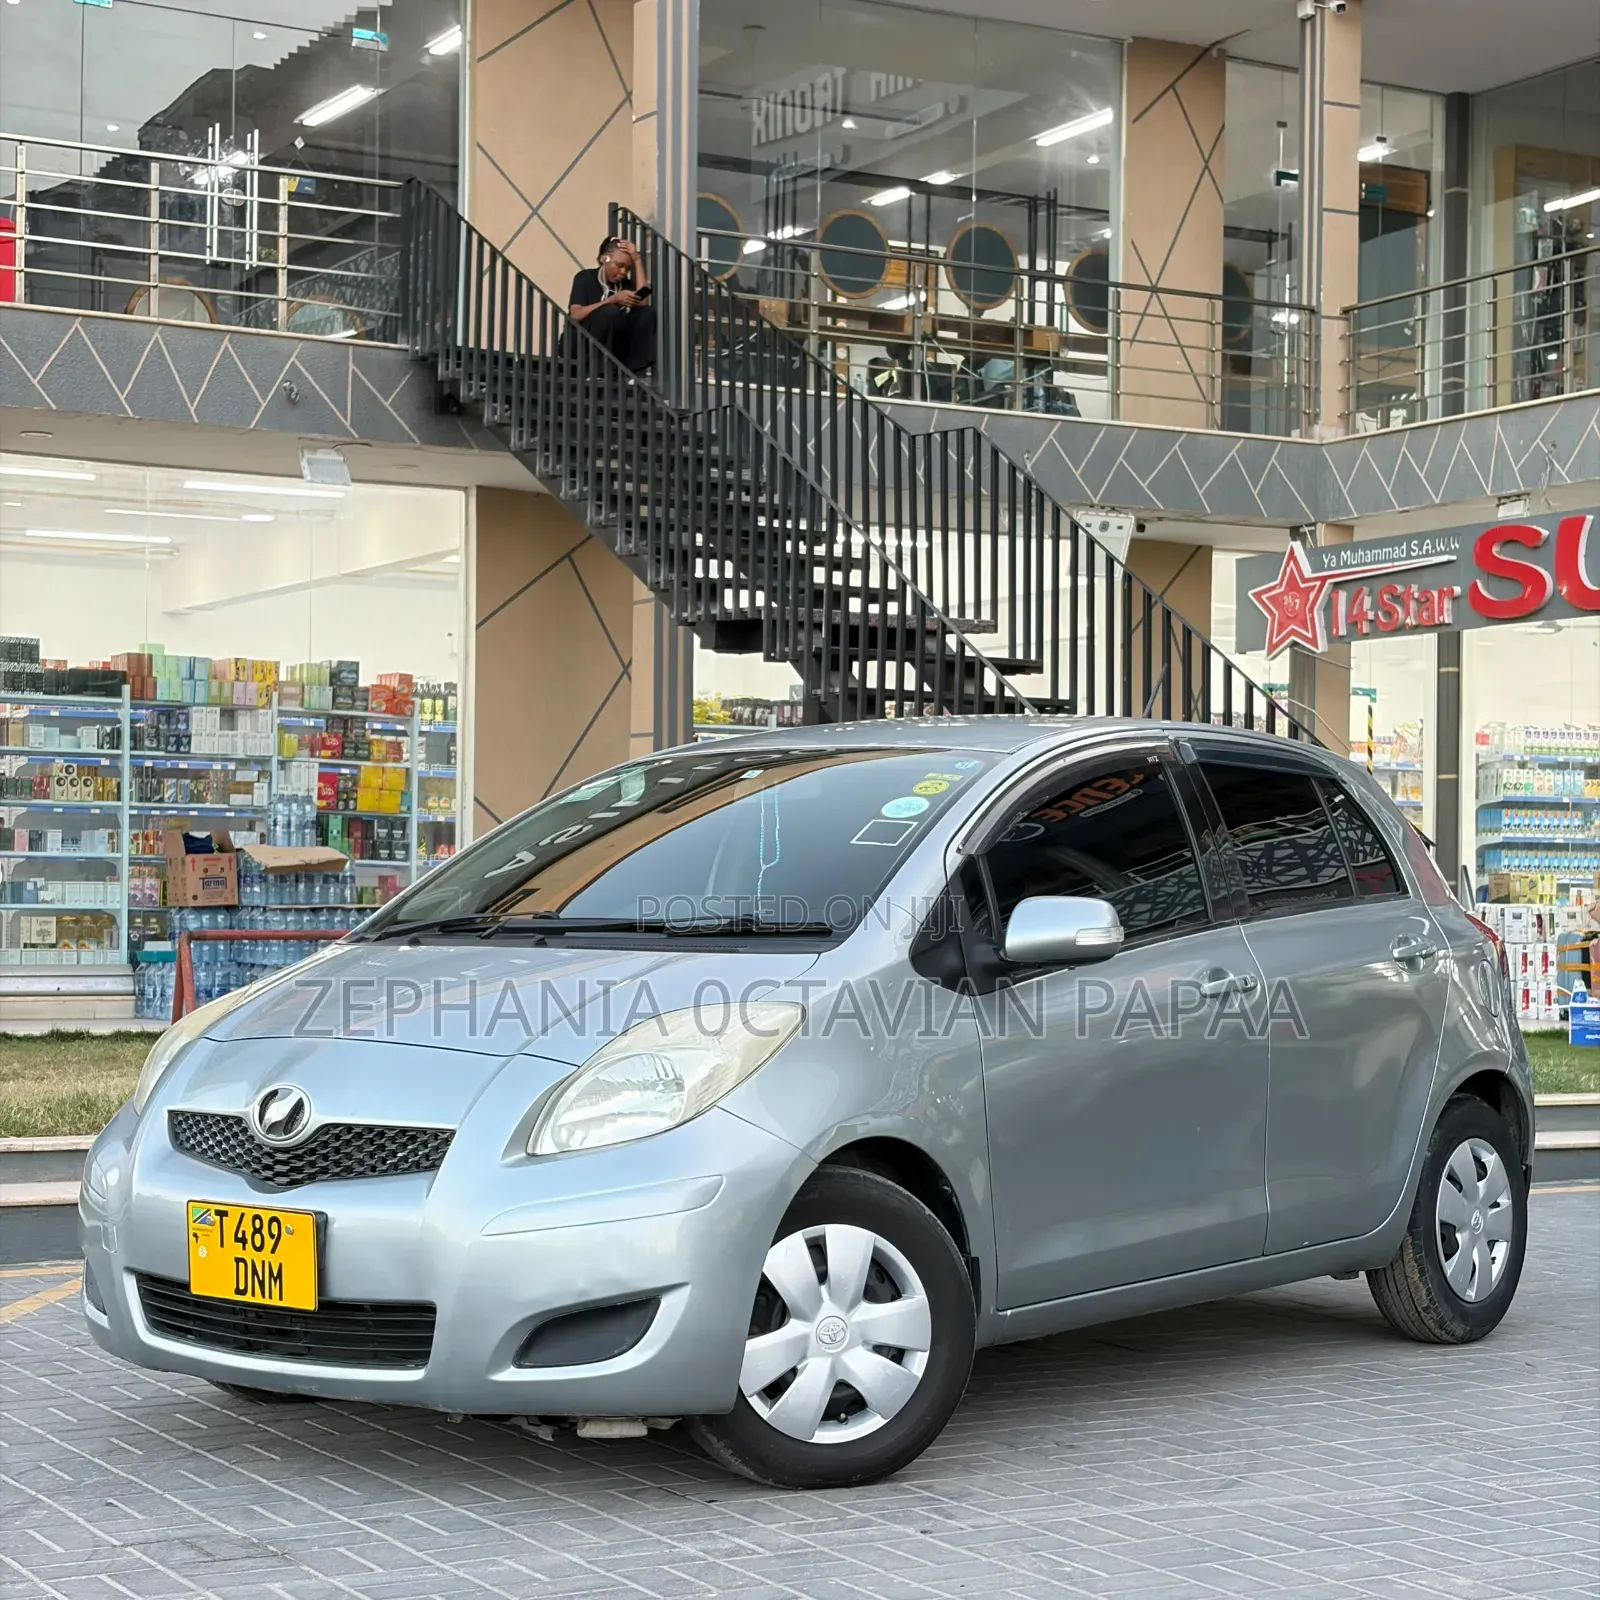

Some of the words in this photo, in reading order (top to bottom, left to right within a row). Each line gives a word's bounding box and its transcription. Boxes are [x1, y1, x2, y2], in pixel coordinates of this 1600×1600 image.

[1322, 552, 1336, 568] Ya
[1340, 542, 1407, 566] Muhammad
[214, 1209, 229, 1248] T
[234, 1212, 282, 1254] 489
[234, 1256, 283, 1301] DNM
